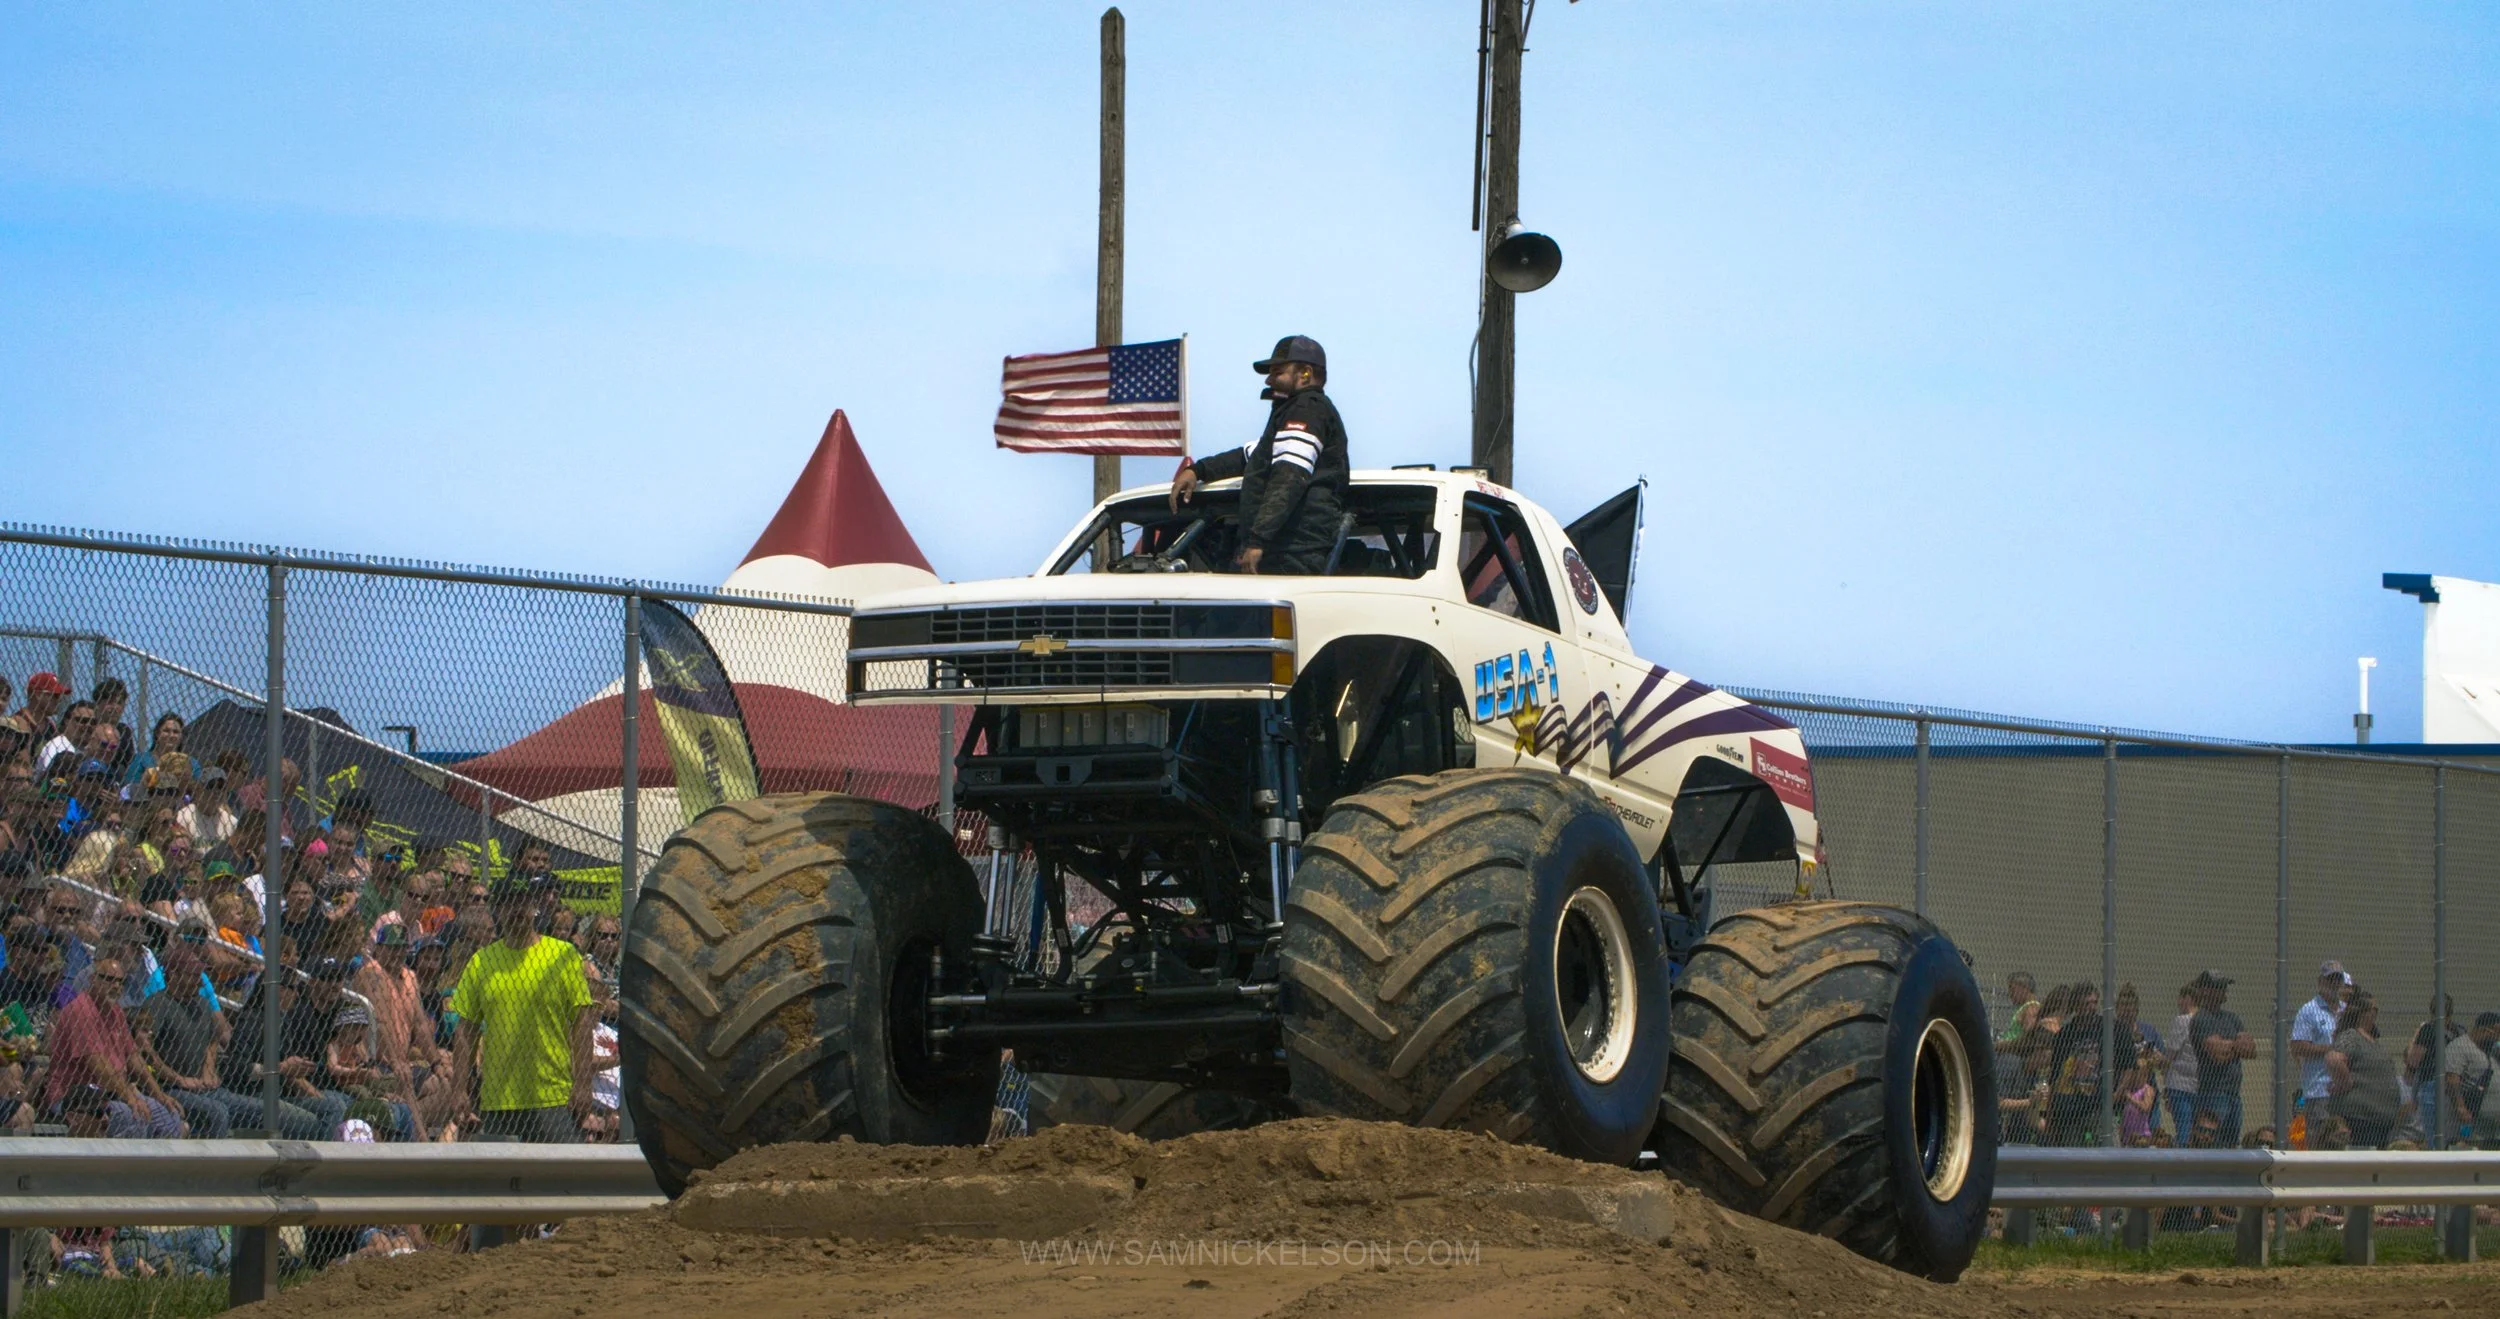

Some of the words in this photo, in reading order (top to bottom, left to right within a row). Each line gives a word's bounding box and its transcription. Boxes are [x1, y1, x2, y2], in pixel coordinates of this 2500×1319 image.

[1475, 641, 1559, 725] USA-1
[1716, 743, 1744, 763] GOODYEAR
[1615, 805, 1655, 830] CHEVROLET
